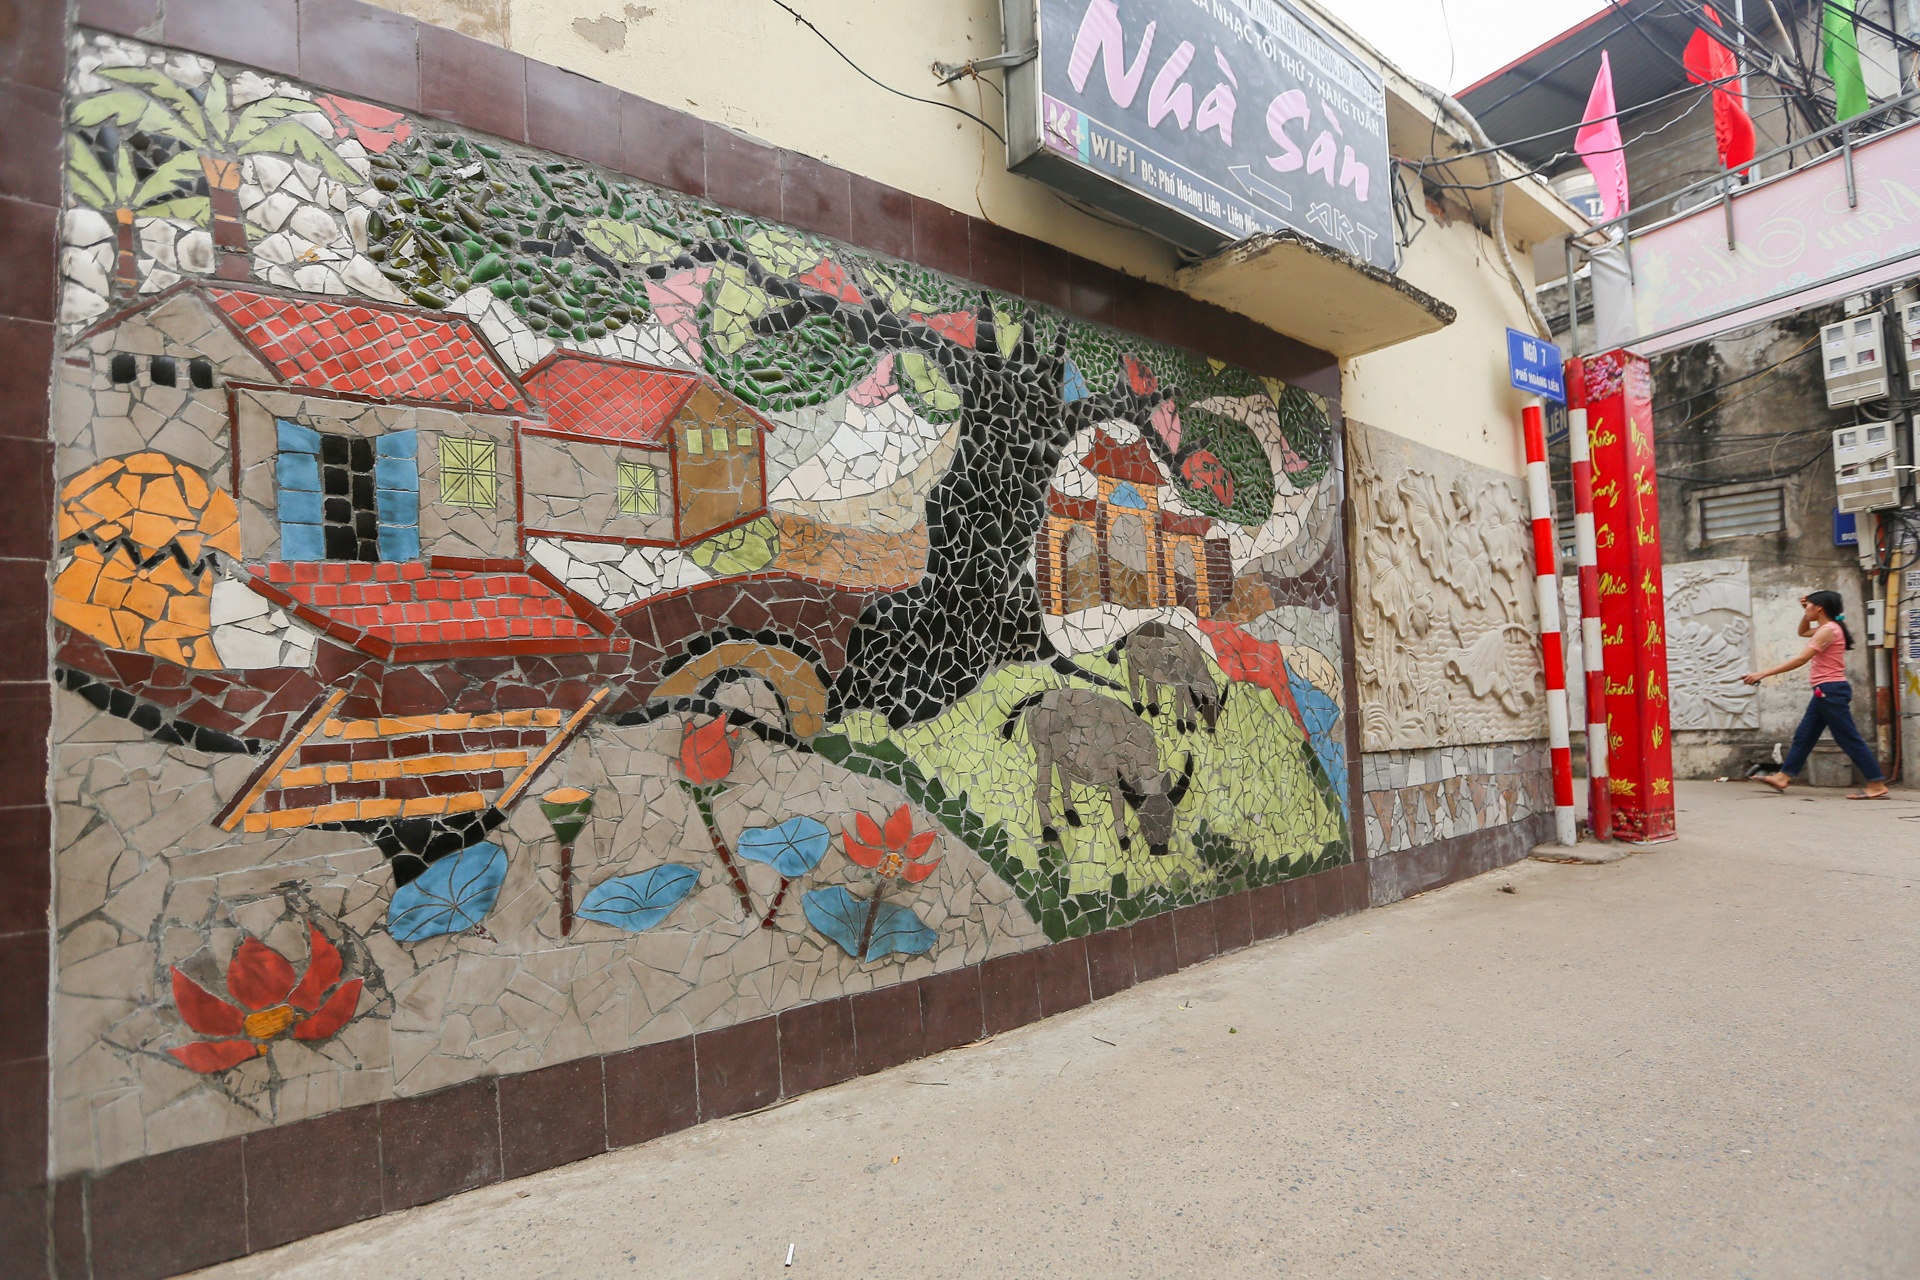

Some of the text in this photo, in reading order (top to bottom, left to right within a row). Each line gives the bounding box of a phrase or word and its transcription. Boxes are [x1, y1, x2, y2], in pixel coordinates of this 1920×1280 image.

[1212, 0, 1253, 45] NHẠC
[1254, 31, 1277, 63] TỐI
[1307, 71, 1314, 88] 7
[1316, 74, 1349, 116] HÀNG
[1067, 0, 1370, 202] Nhà Sàn
[1090, 131, 1136, 174] WIFI
[1141, 159, 1157, 188] ĐC:
[1158, 168, 1176, 196] Phố
[1177, 177, 1203, 213] Hoàng
[1203, 191, 1222, 218] Liên
[1227, 203, 1244, 230] Liên
[1305, 202, 1378, 262] ART
[1515, 367, 1560, 393] PHỐ HOÀNG LIÊN
[1541, 347, 1546, 367] 7
